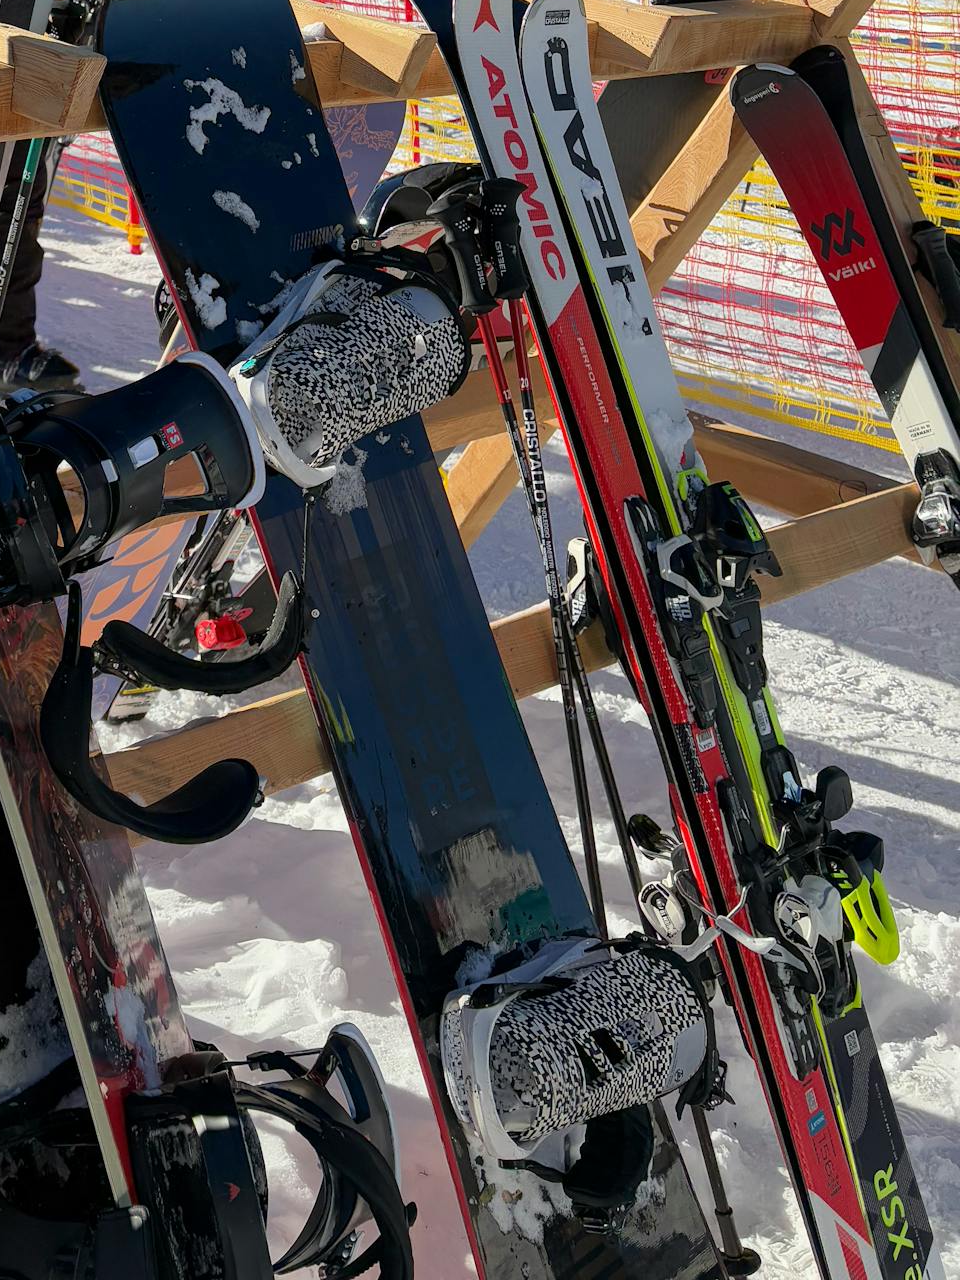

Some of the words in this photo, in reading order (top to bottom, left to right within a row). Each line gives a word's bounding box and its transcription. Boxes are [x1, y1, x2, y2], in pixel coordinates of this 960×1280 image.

[480, 53, 566, 283] ATOMIC
[494, 241, 507, 277] GABEL
[576, 337, 610, 423] PERFORMER
[523, 408, 547, 503] CRISTALLO
